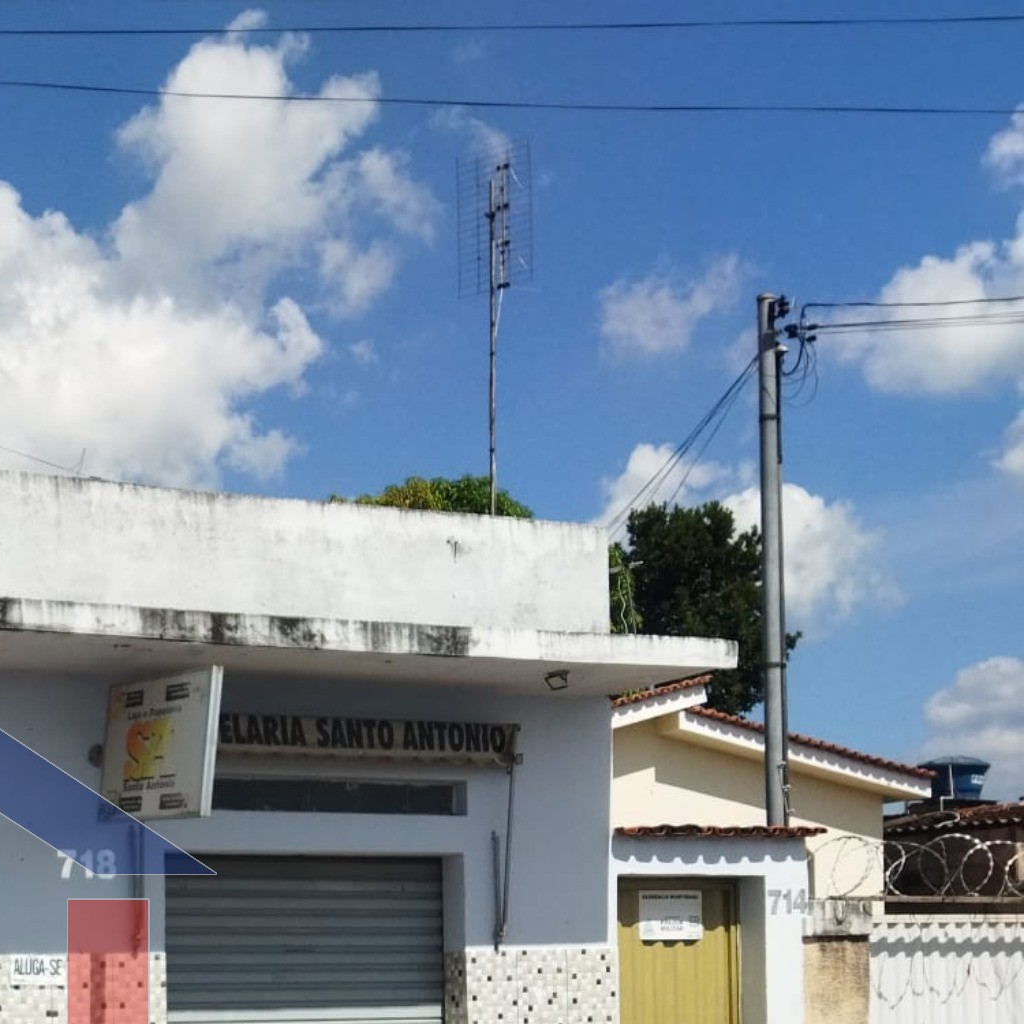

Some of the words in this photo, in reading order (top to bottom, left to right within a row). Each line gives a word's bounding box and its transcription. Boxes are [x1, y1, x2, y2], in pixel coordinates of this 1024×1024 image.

[316, 716, 394, 750] SANTO
[403, 720, 506, 753] ANTONIO
[57, 849, 117, 879] 718
[767, 888, 808, 915] 714
[14, 959, 63, 976] ALUGA-SE
